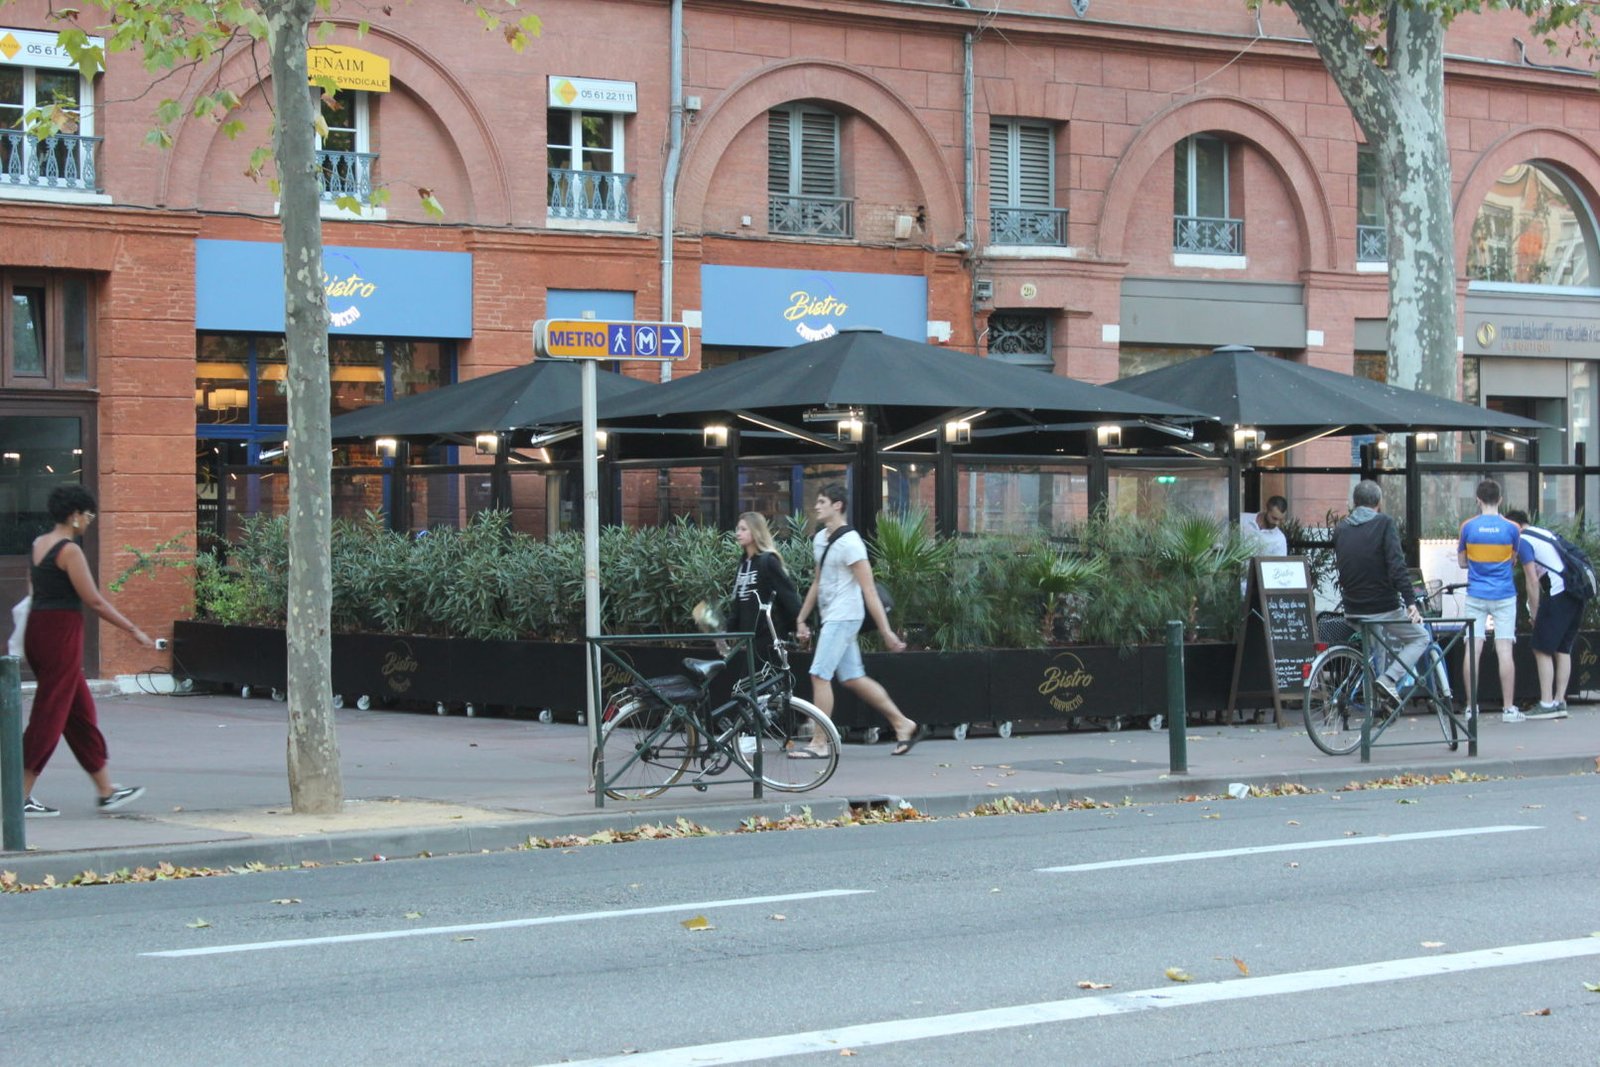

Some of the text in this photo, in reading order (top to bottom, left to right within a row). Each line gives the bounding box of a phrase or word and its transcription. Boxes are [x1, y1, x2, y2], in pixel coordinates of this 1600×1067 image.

[27, 44, 42, 55] 05
[44, 46, 57, 56] 61
[314, 56, 364, 73] FNAIM
[337, 75, 388, 87] SYNDICALE
[581, 90, 592, 98] 05
[594, 91, 604, 99] 61
[606, 92, 617, 101] 22
[784, 290, 848, 321] Bistro
[549, 330, 606, 347] METRO
[1038, 666, 1095, 695] Bistro
